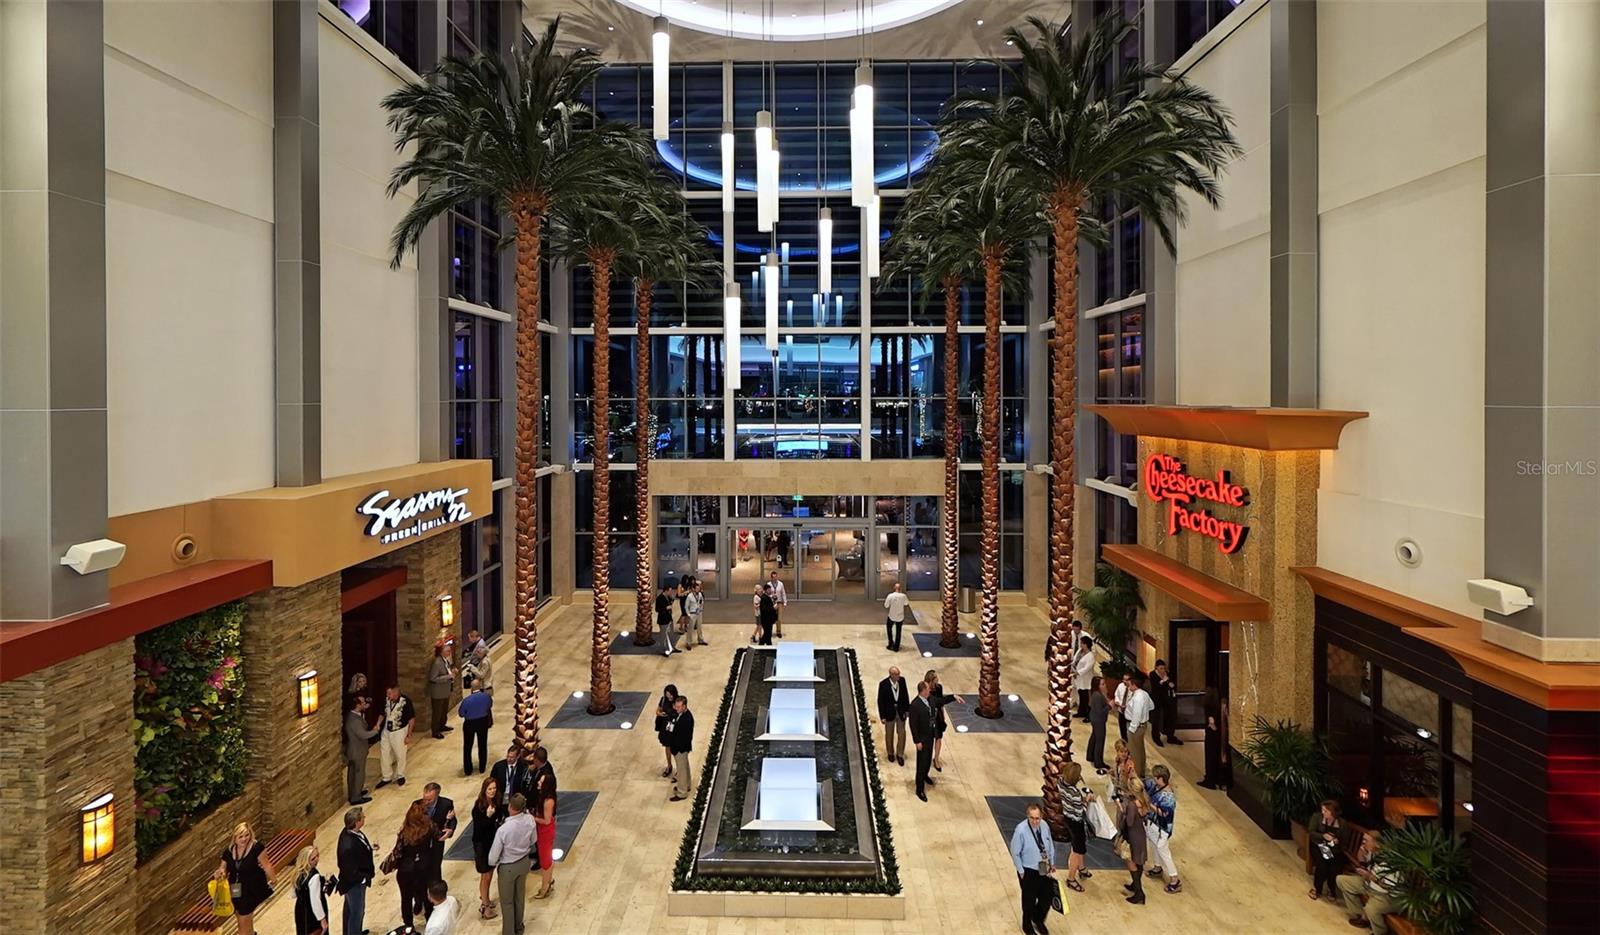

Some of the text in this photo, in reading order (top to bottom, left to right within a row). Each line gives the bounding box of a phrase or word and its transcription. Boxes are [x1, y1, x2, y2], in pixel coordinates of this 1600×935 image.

[1144, 453, 1245, 507] Cheesecake
[1163, 456, 1182, 473] The
[360, 487, 472, 536] Seasons 52
[1162, 489, 1244, 554] Factory
